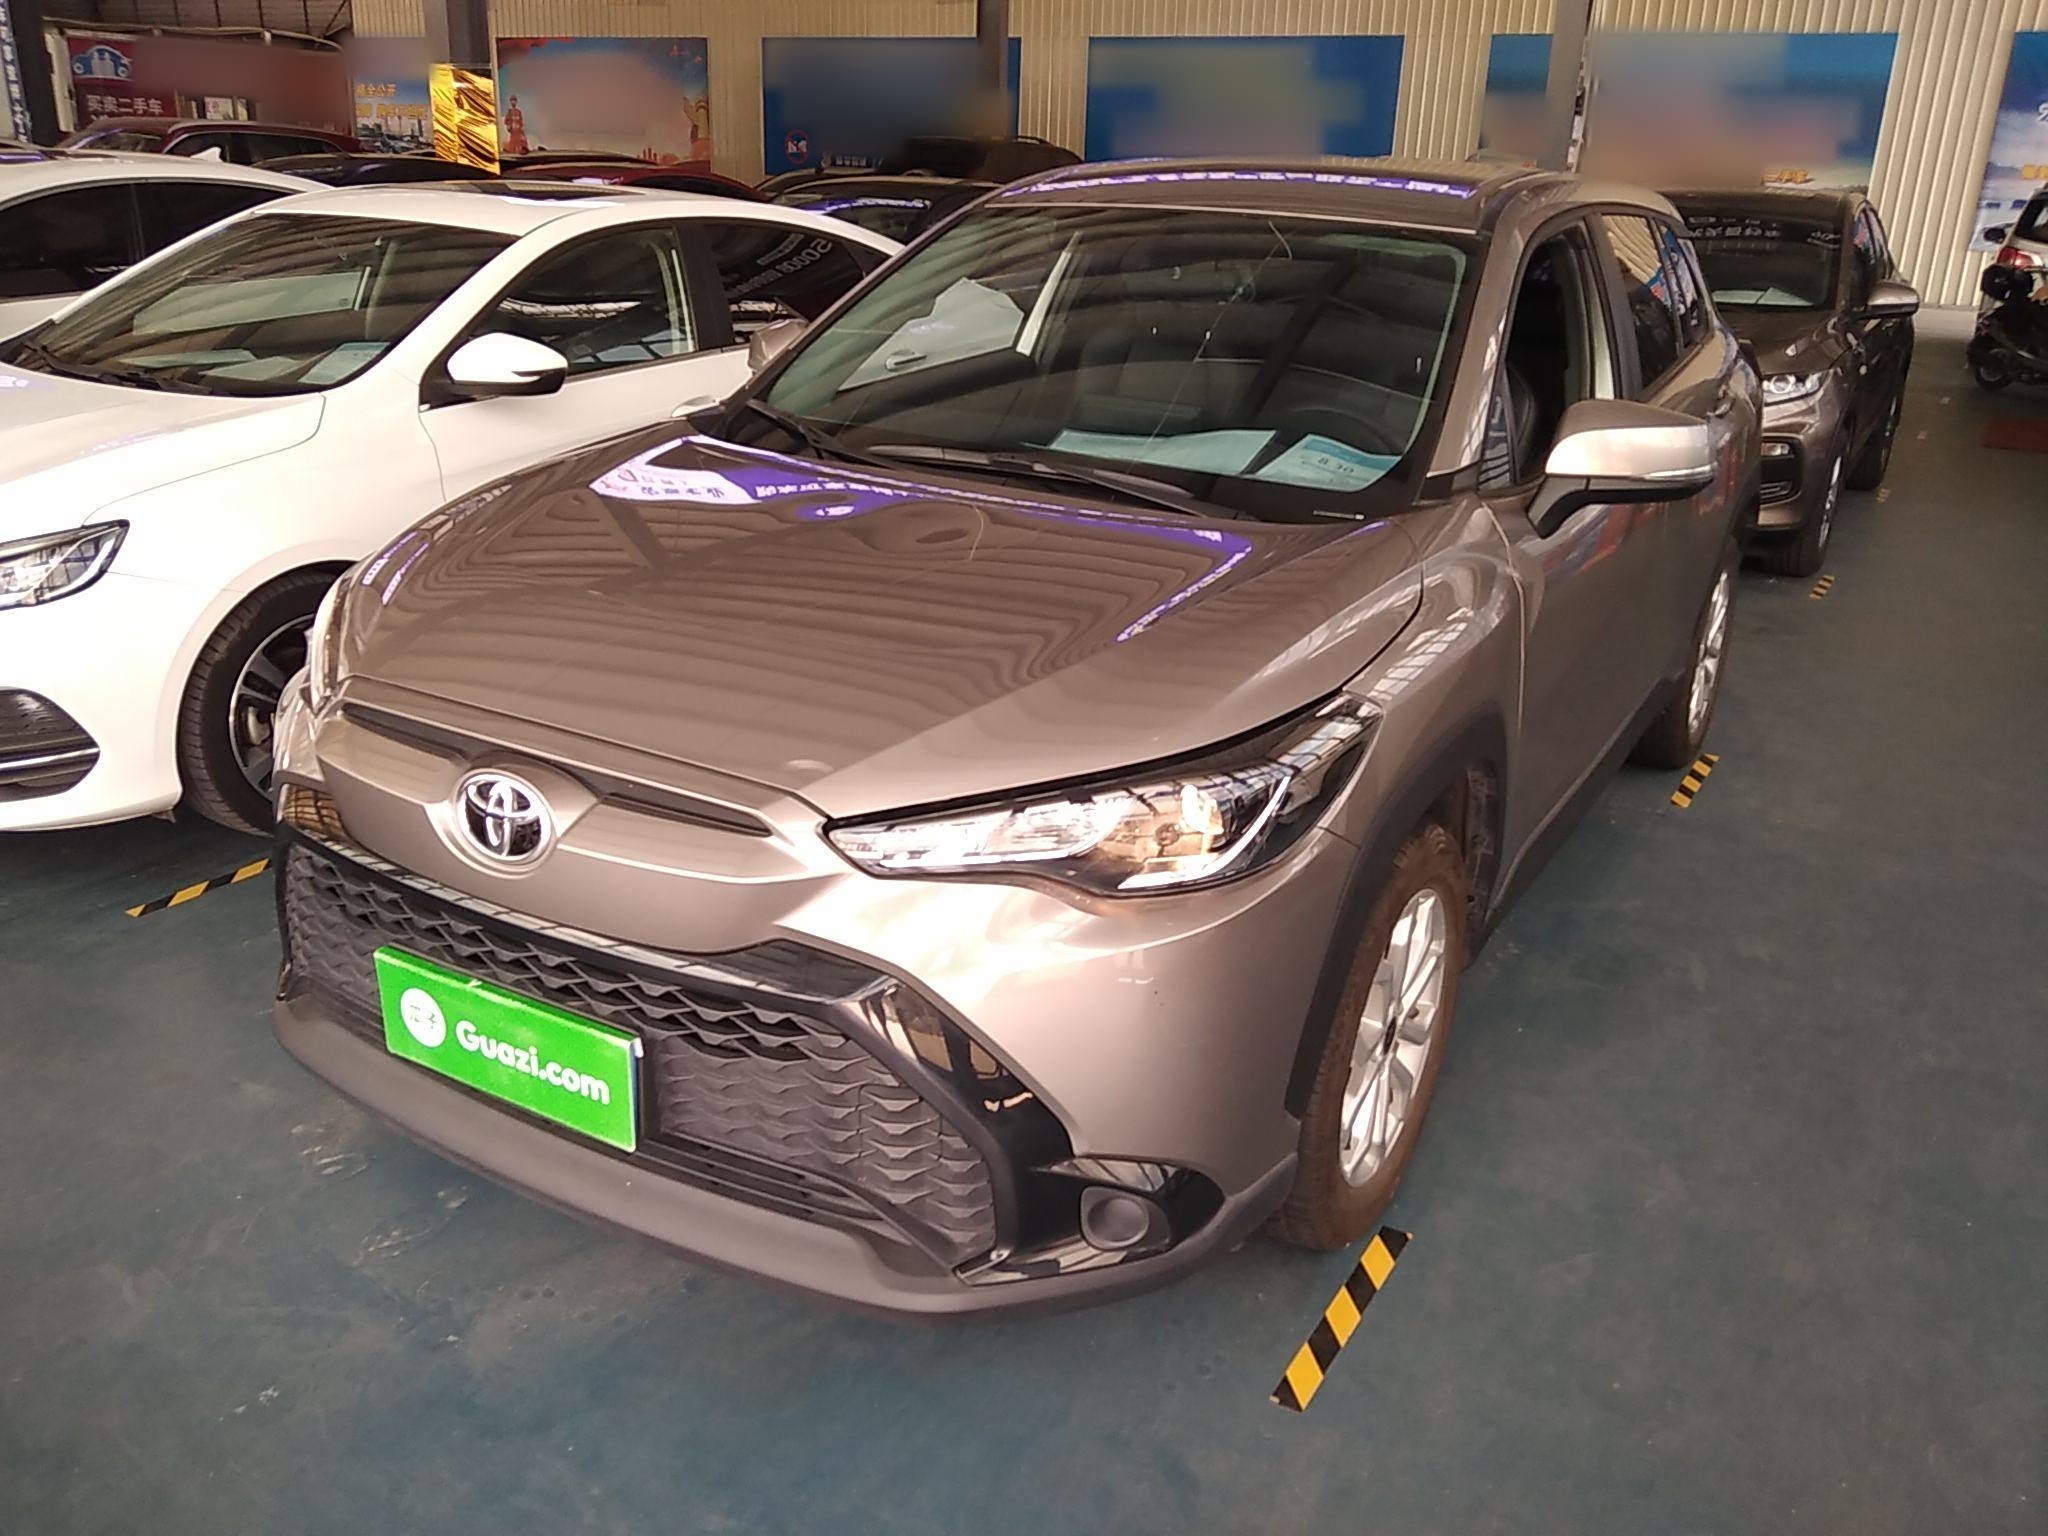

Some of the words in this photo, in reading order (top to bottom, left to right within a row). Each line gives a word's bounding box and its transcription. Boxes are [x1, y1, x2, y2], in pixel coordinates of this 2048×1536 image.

[86, 94, 164, 116] 买卖二手车
[455, 1020, 611, 1105] Guazi.com
